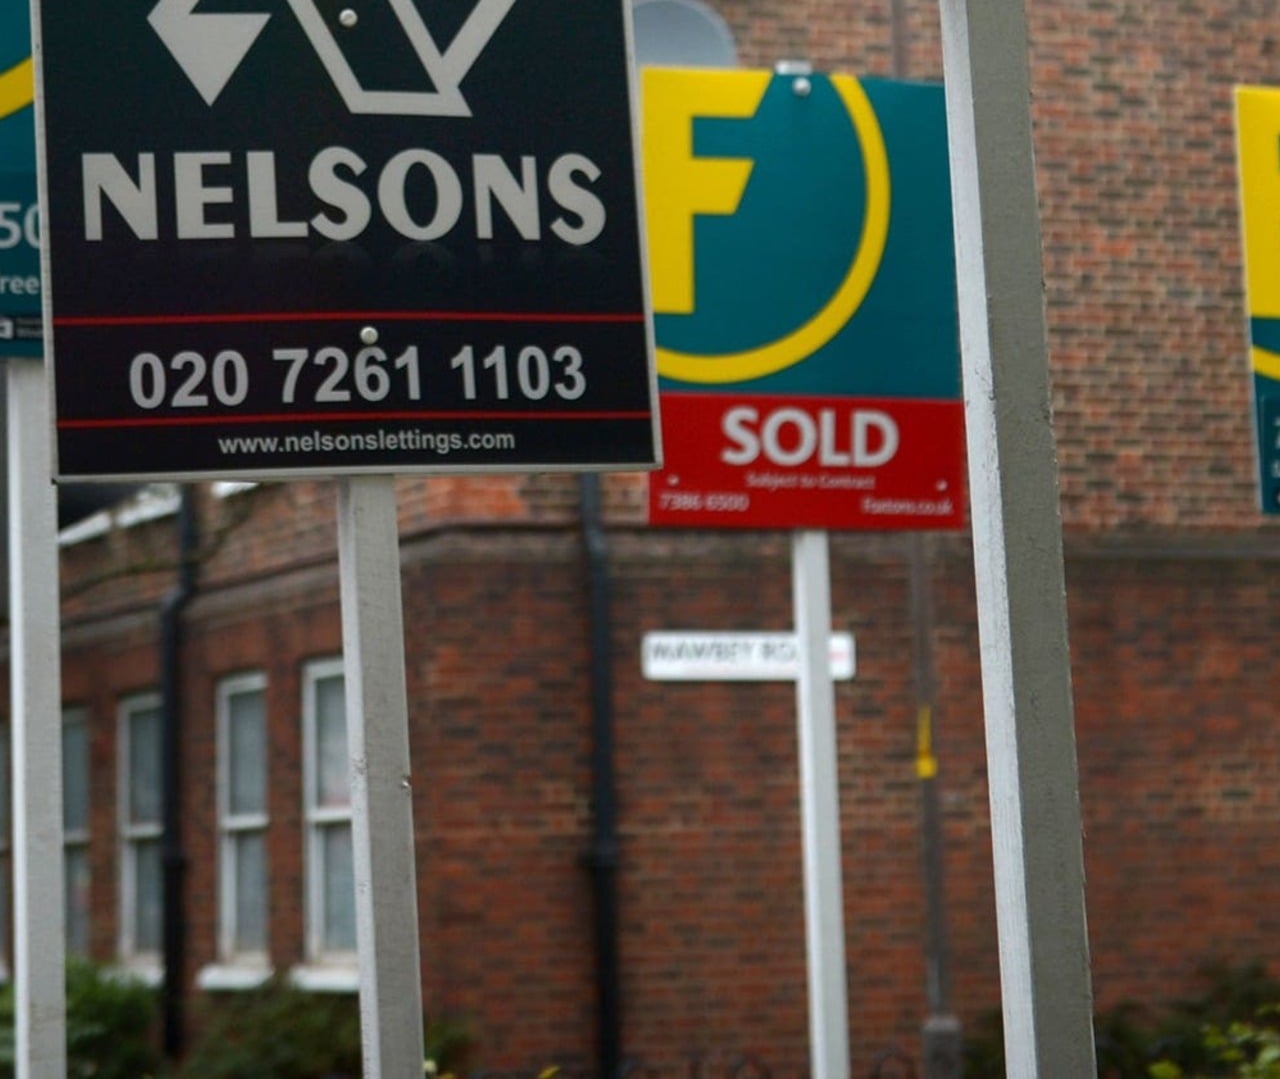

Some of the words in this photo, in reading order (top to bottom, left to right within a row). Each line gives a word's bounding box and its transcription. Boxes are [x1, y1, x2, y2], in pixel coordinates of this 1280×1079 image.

[81, 145, 607, 246] NELSONS
[128, 350, 249, 409] 020
[272, 345, 422, 405] 7261
[450, 344, 588, 401] 1103
[218, 428, 516, 456] www.nelsonslettings.com
[720, 405, 900, 467] SOLD
